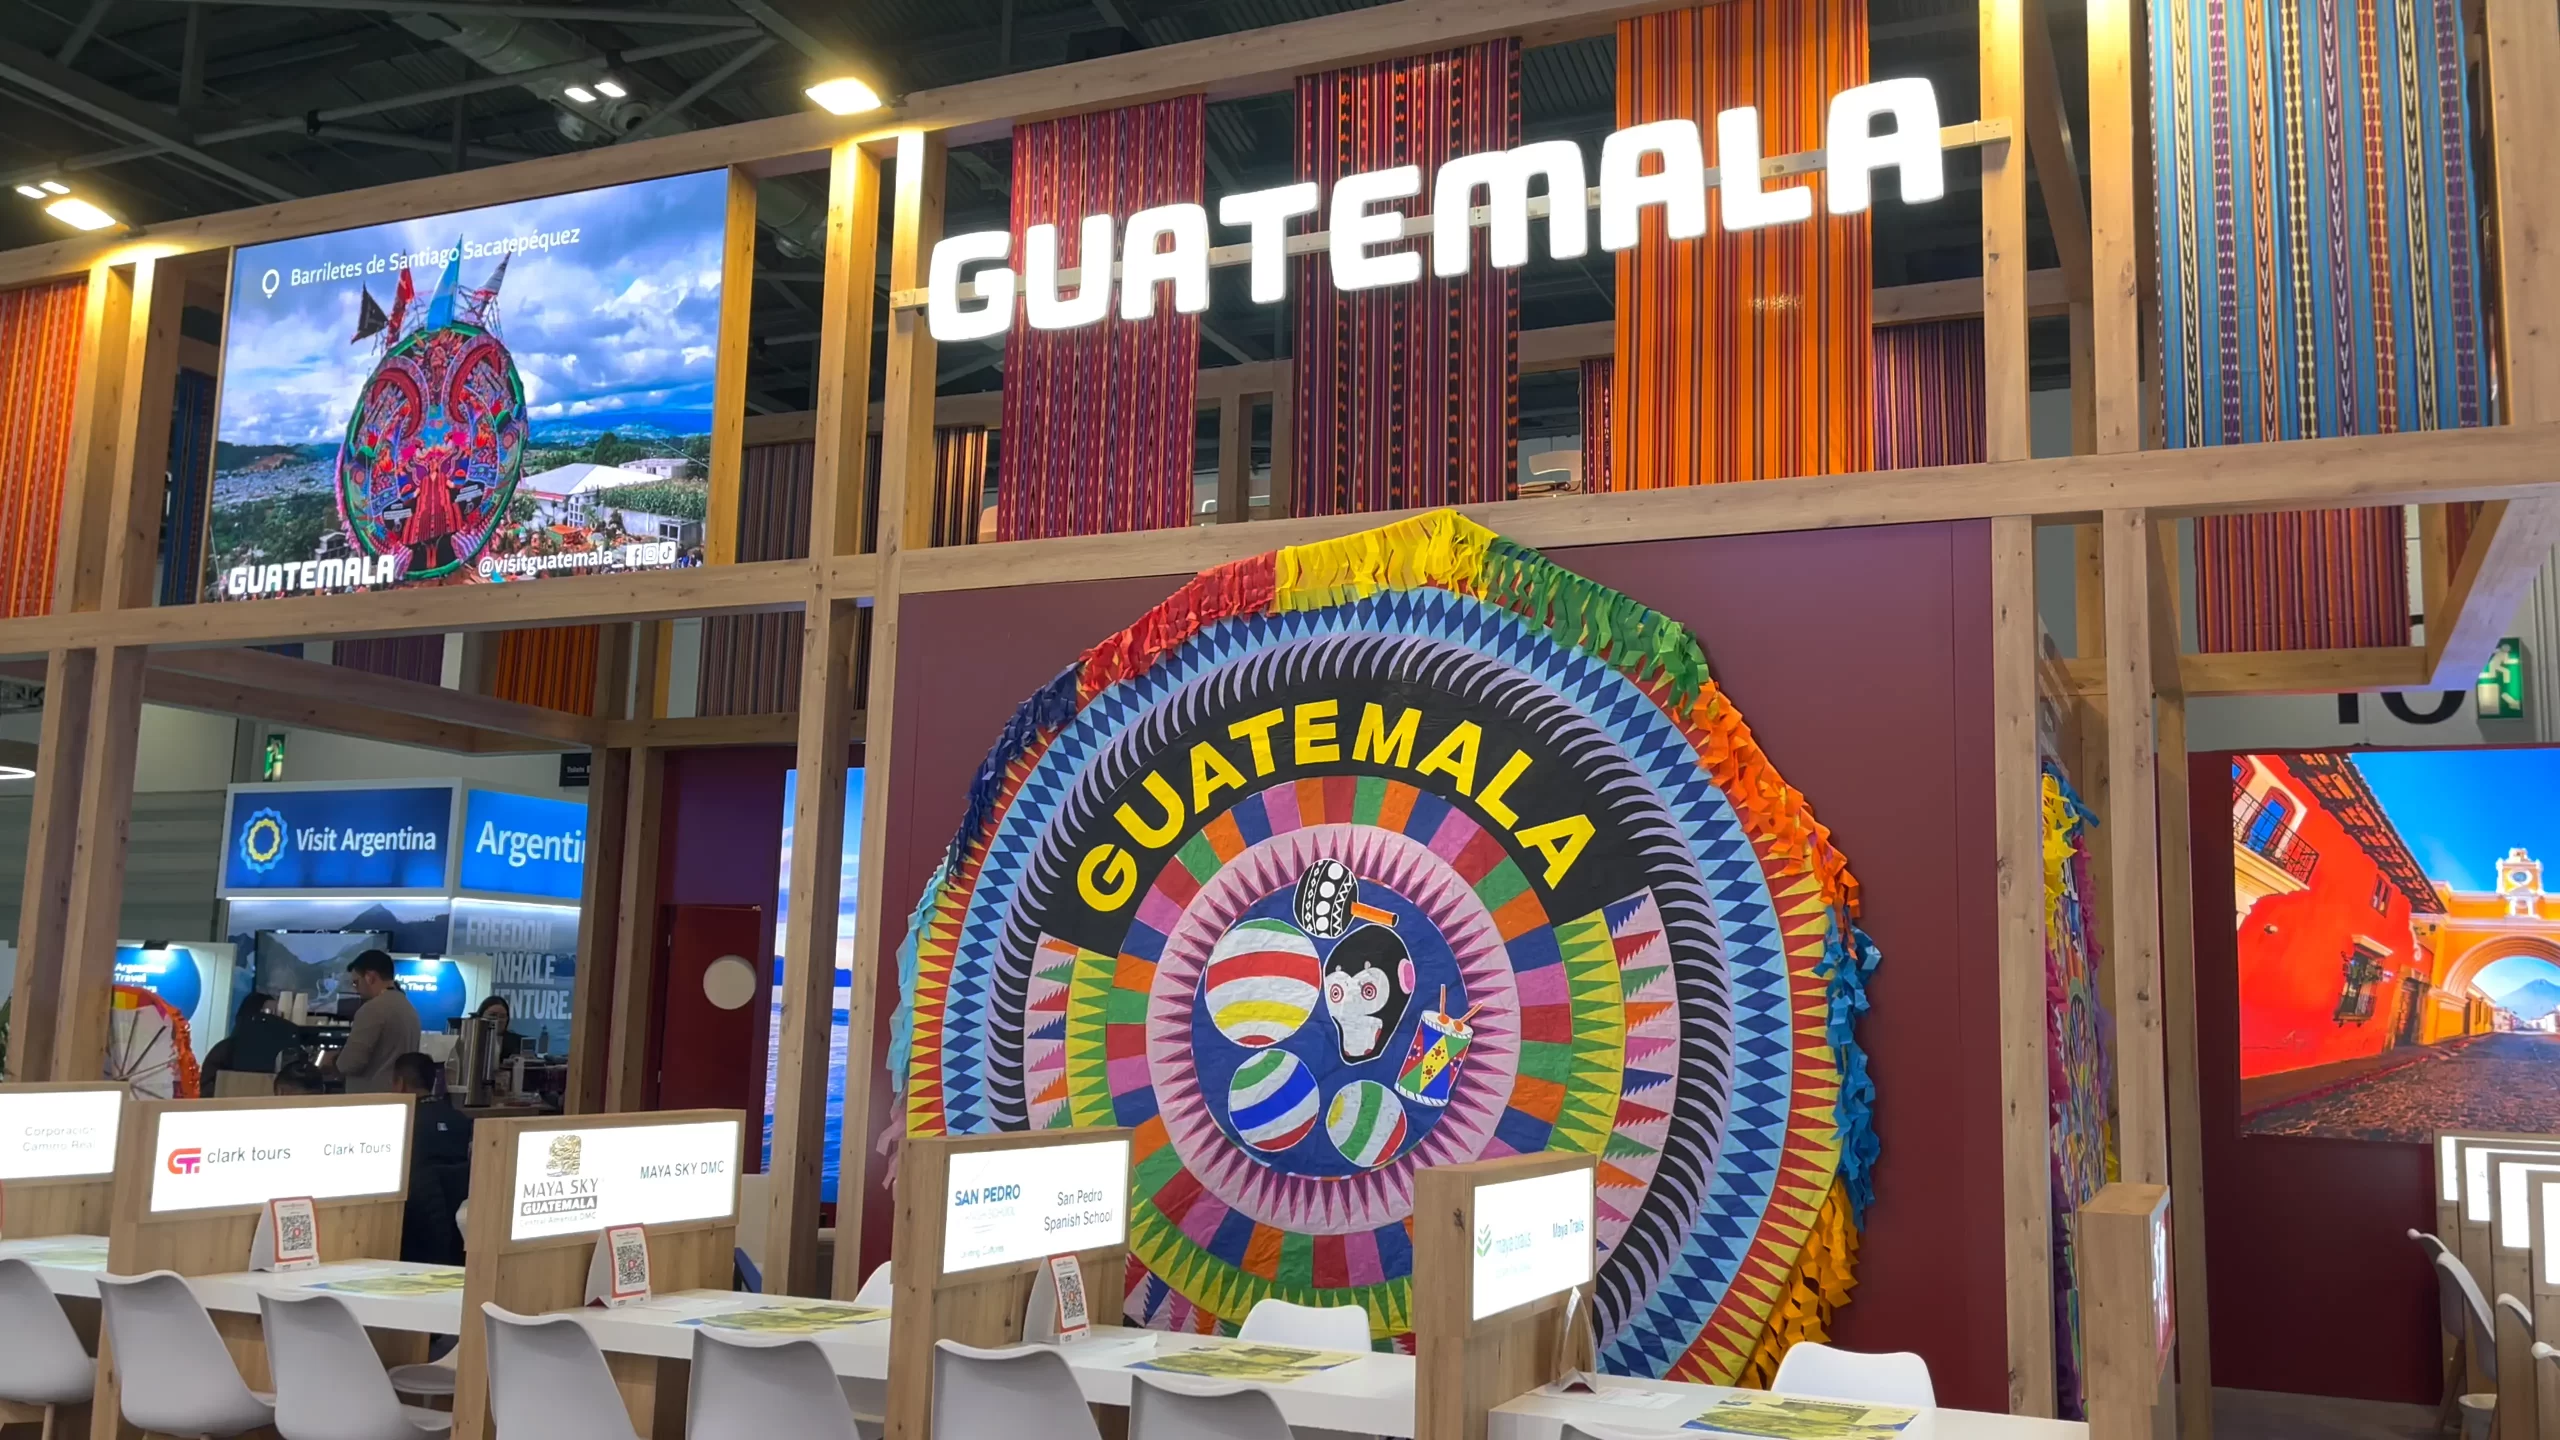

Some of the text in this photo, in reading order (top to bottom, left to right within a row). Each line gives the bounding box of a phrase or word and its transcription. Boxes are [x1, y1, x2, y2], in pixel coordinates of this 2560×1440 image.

[927, 76, 1945, 341] GUATEMALA
[291, 228, 580, 287] Barriletes de Santiago Sacatepéquez
[228, 554, 395, 594] GUATEMALA
[478, 546, 624, 577] @visitguatemala_
[1077, 699, 1596, 911] GUATEMALA
[296, 826, 436, 857] Visit Argentina
[466, 917, 552, 949] FREEDOM
[114, 973, 147, 983] Travel
[493, 951, 556, 984] INHALE
[207, 1147, 245, 1164] clark
[251, 1146, 291, 1162] tours
[324, 1142, 391, 1156] Clark Tours
[640, 1160, 724, 1179] MAYA SKY DMC
[523, 1178, 598, 1199] MAYA SKY
[955, 1184, 1020, 1206] SAN PEDRO
[1057, 1188, 1102, 1206] San Pedro
[522, 1197, 595, 1215] GUATEMALA
[1044, 1208, 1113, 1234] Spanish School
